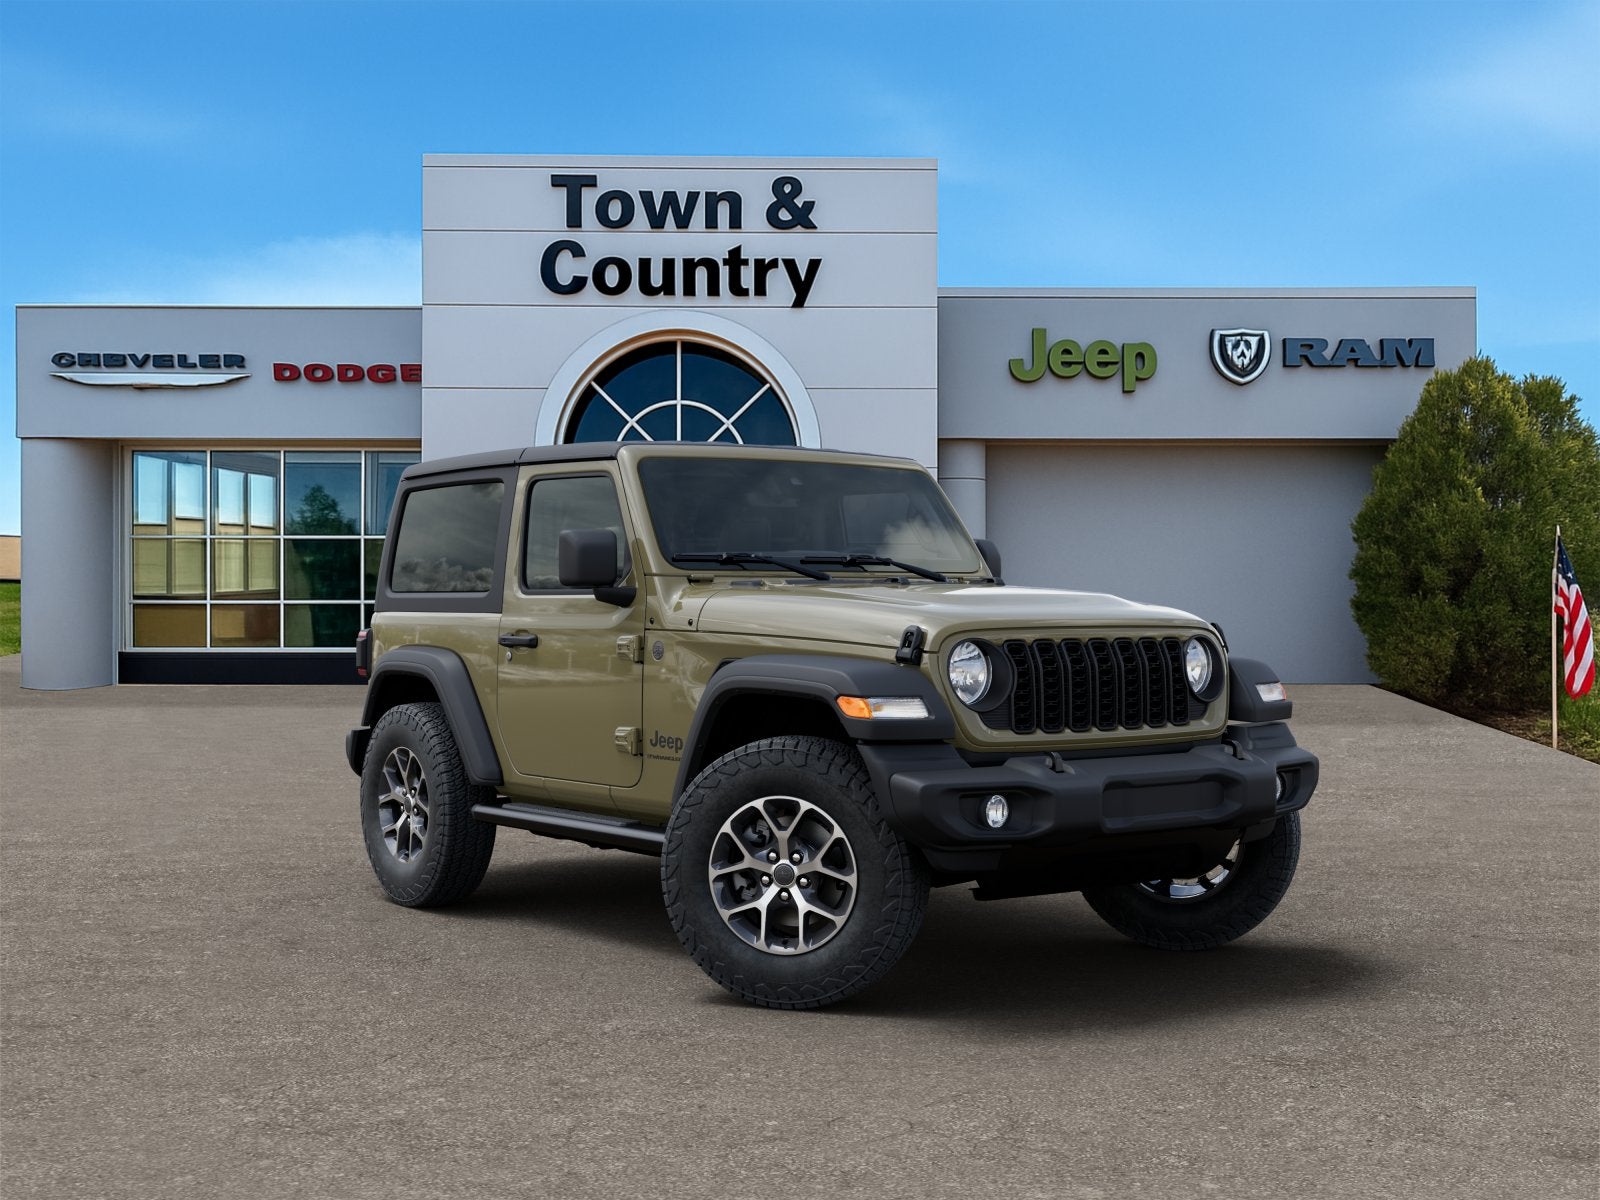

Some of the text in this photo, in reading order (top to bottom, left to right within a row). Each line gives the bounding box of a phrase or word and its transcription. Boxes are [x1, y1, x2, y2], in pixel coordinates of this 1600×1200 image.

[550, 173, 818, 230] Town &
[540, 239, 823, 308] Country
[272, 362, 422, 383] DODGE
[1008, 327, 1158, 393] Jeep
[1282, 337, 1435, 368] RAM
[649, 730, 684, 754] Jeep
